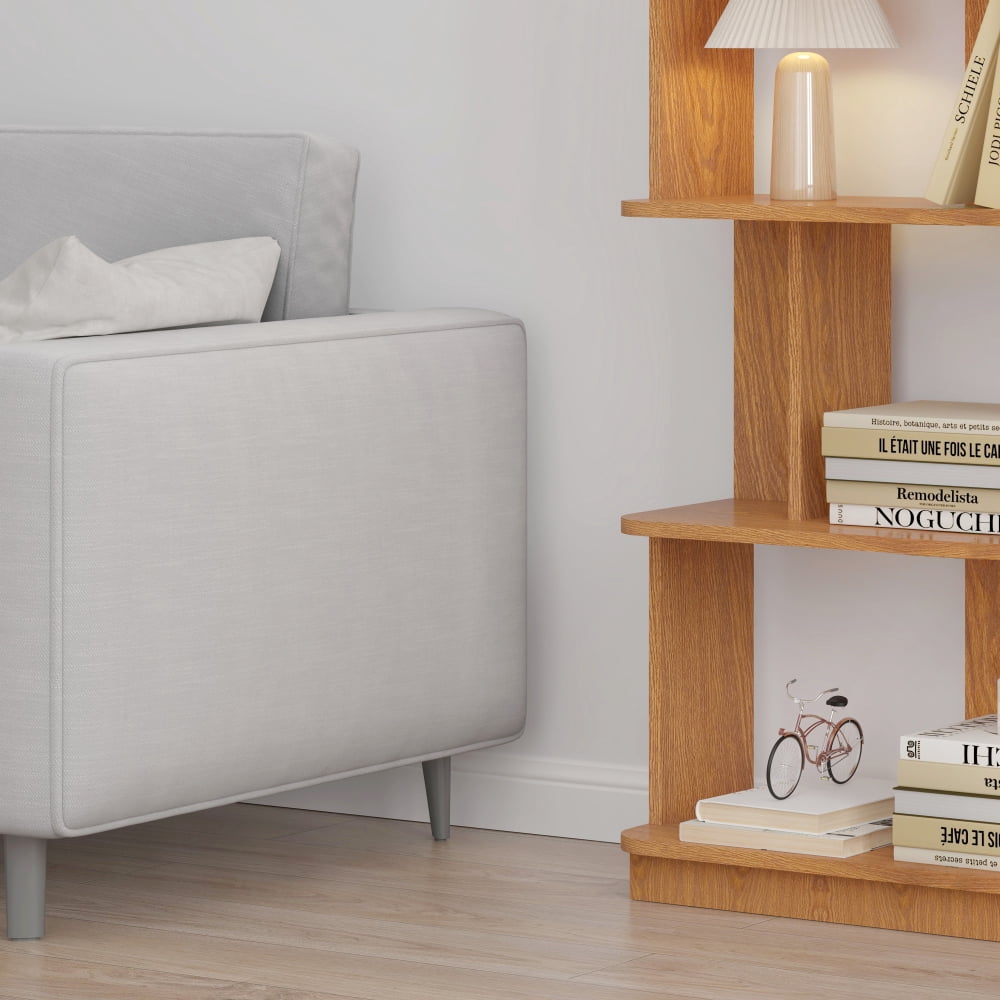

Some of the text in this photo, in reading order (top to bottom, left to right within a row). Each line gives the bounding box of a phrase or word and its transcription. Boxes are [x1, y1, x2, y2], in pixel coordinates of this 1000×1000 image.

[954, 55, 986, 124] SCHIELE
[989, 135, 1000, 167] JODI
[871, 418, 902, 427] Histoire,
[903, 420, 940, 429] botanique,
[959, 422, 967, 430] et
[968, 423, 990, 431] petits
[879, 438, 888, 453] IL
[890, 435, 919, 454] ÉTAIT
[921, 440, 942, 456] UNE
[944, 441, 966, 457] FOIS
[969, 442, 981, 458] LE
[897, 487, 979, 504] Remodelista
[940, 826, 969, 846] CAFÉ
[972, 829, 985, 847] LE
[934, 854, 963, 864] secrets
[965, 857, 988, 867] petits
[990, 860, 998, 868] et
